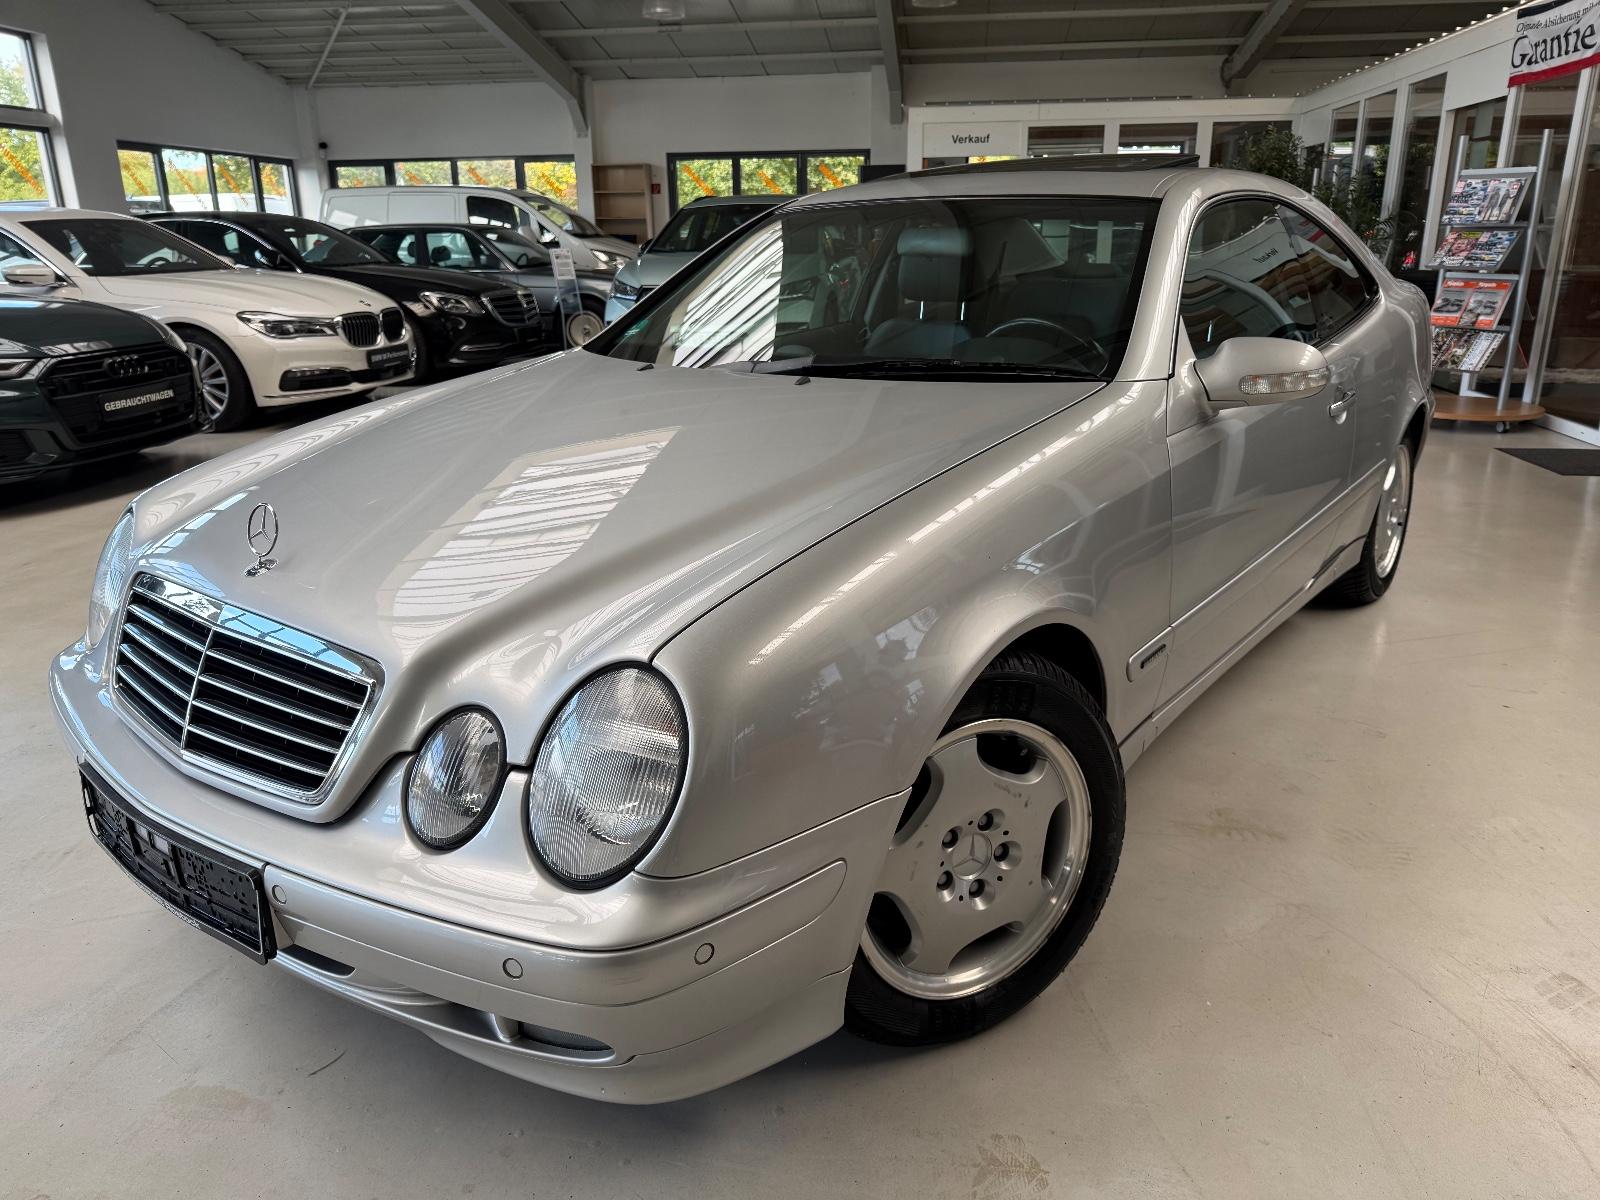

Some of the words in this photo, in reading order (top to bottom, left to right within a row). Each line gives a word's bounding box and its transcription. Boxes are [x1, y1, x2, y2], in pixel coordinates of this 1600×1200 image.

[1541, 9, 1581, 29] Absicherung
[951, 133, 991, 144] Verkauf
[104, 388, 174, 412] GEBRAUCHTWAGEN
